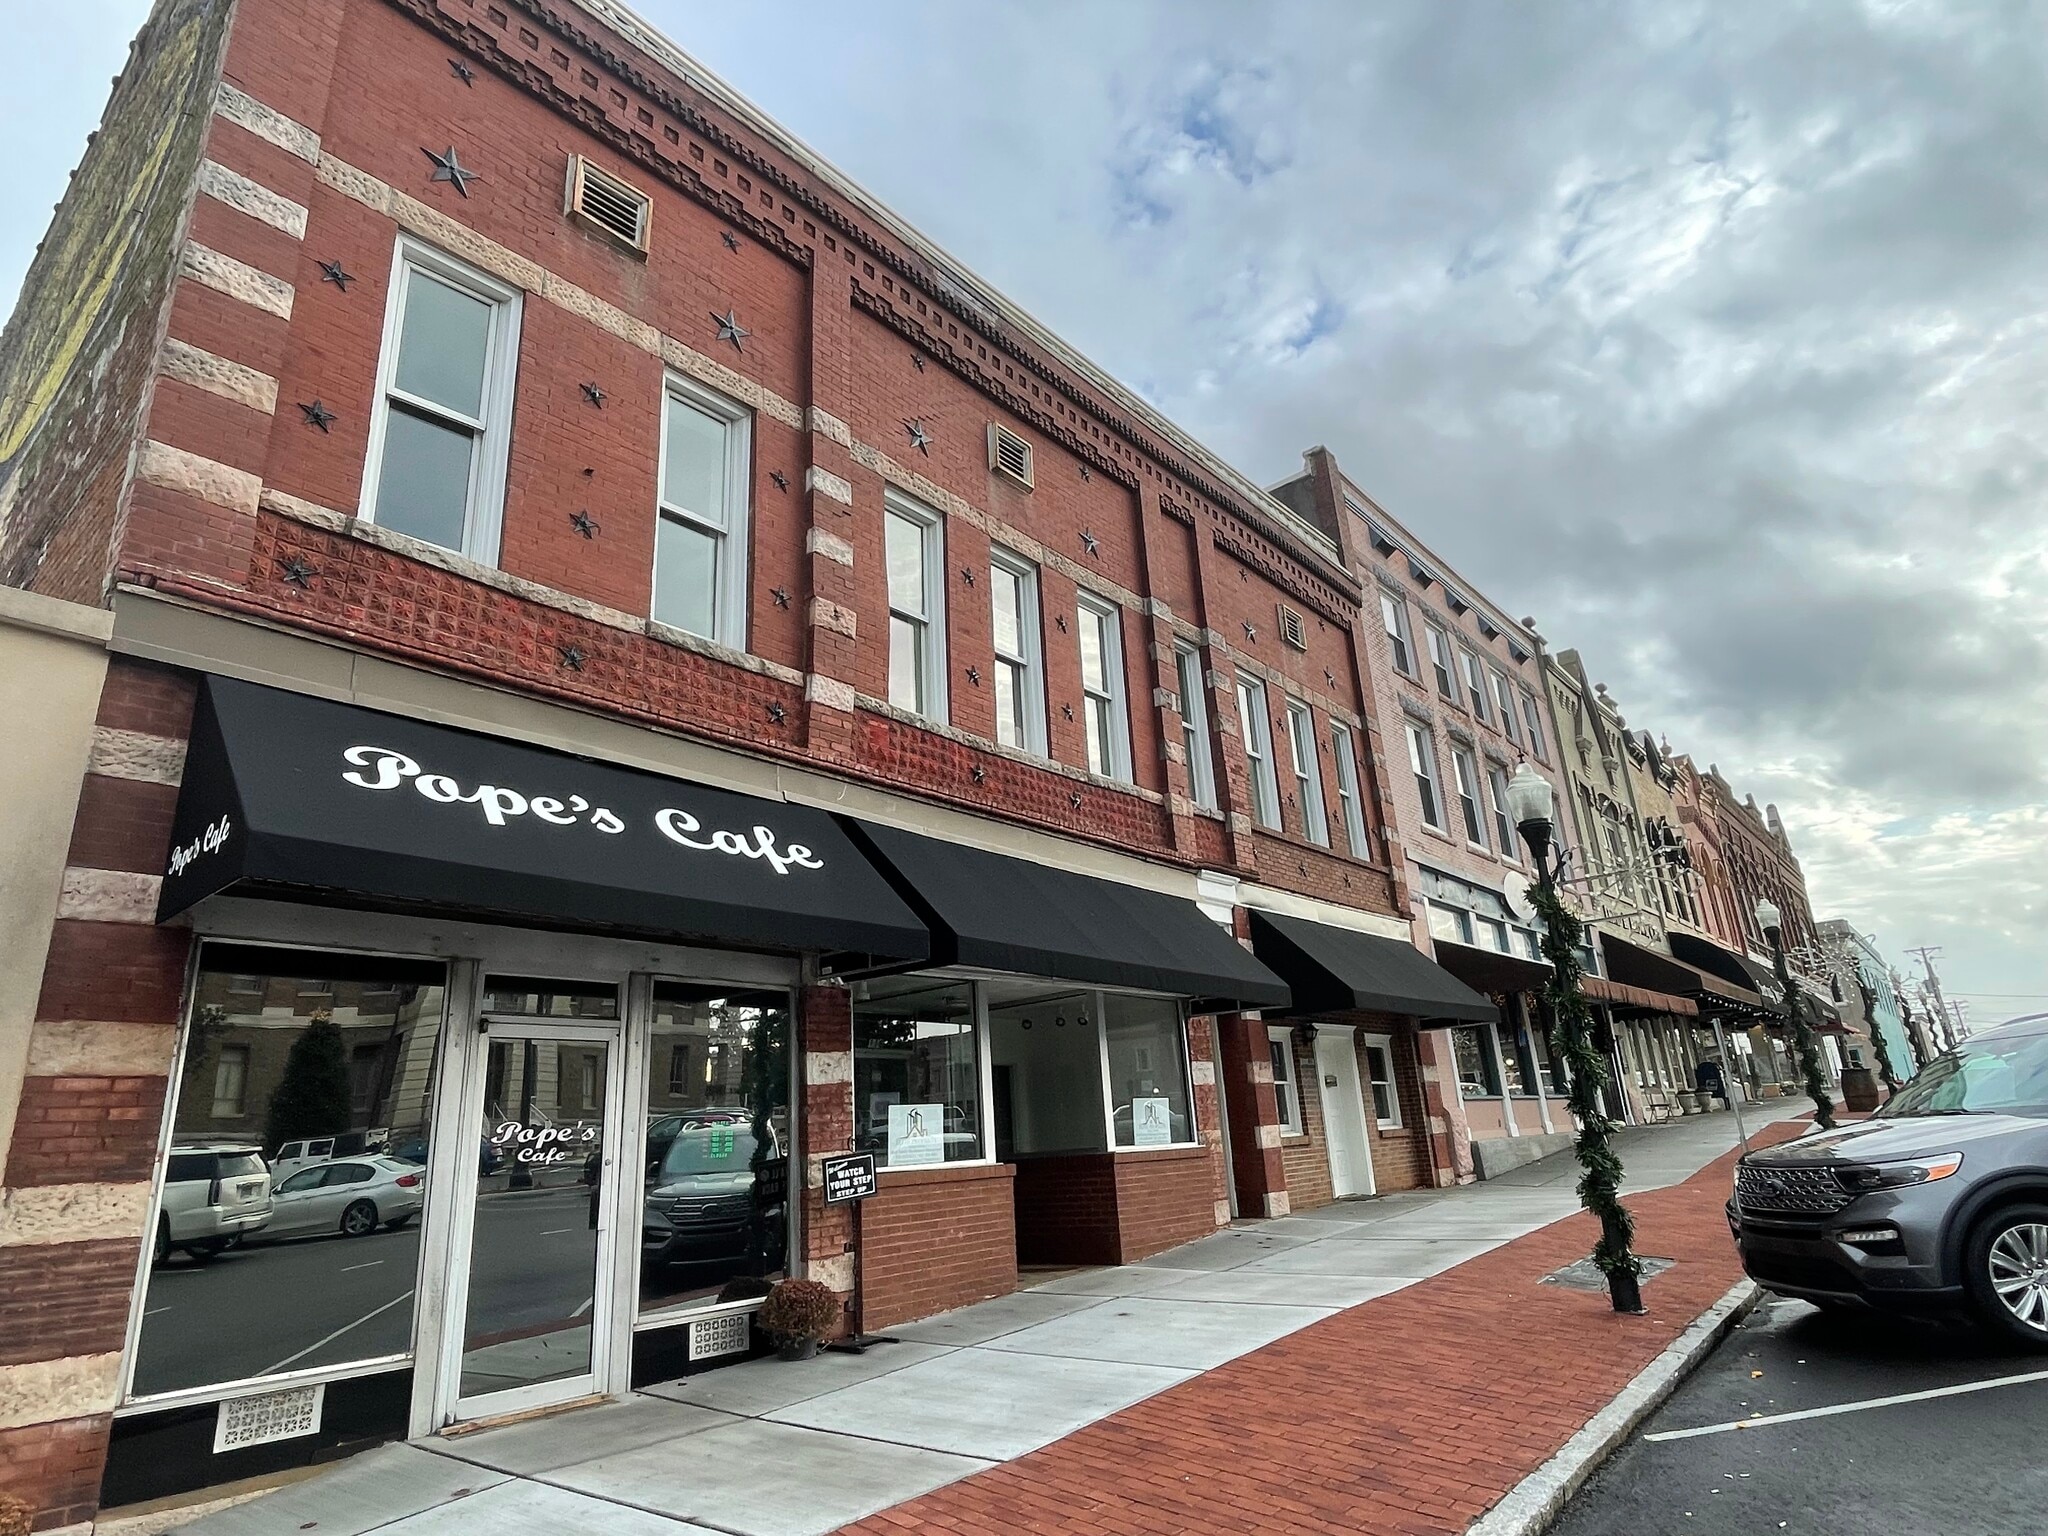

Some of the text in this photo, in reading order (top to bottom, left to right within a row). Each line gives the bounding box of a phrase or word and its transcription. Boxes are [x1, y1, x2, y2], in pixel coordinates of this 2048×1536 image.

[342, 745, 825, 874] Pope's Cafe
[203, 814, 230, 854] Cafe
[491, 1121, 595, 1148] Pope's
[517, 1147, 565, 1164] Cafe
[837, 1167, 864, 1179] WATCH
[830, 1175, 872, 1190] YOUR STEP
[836, 1188, 855, 1197] STEP
